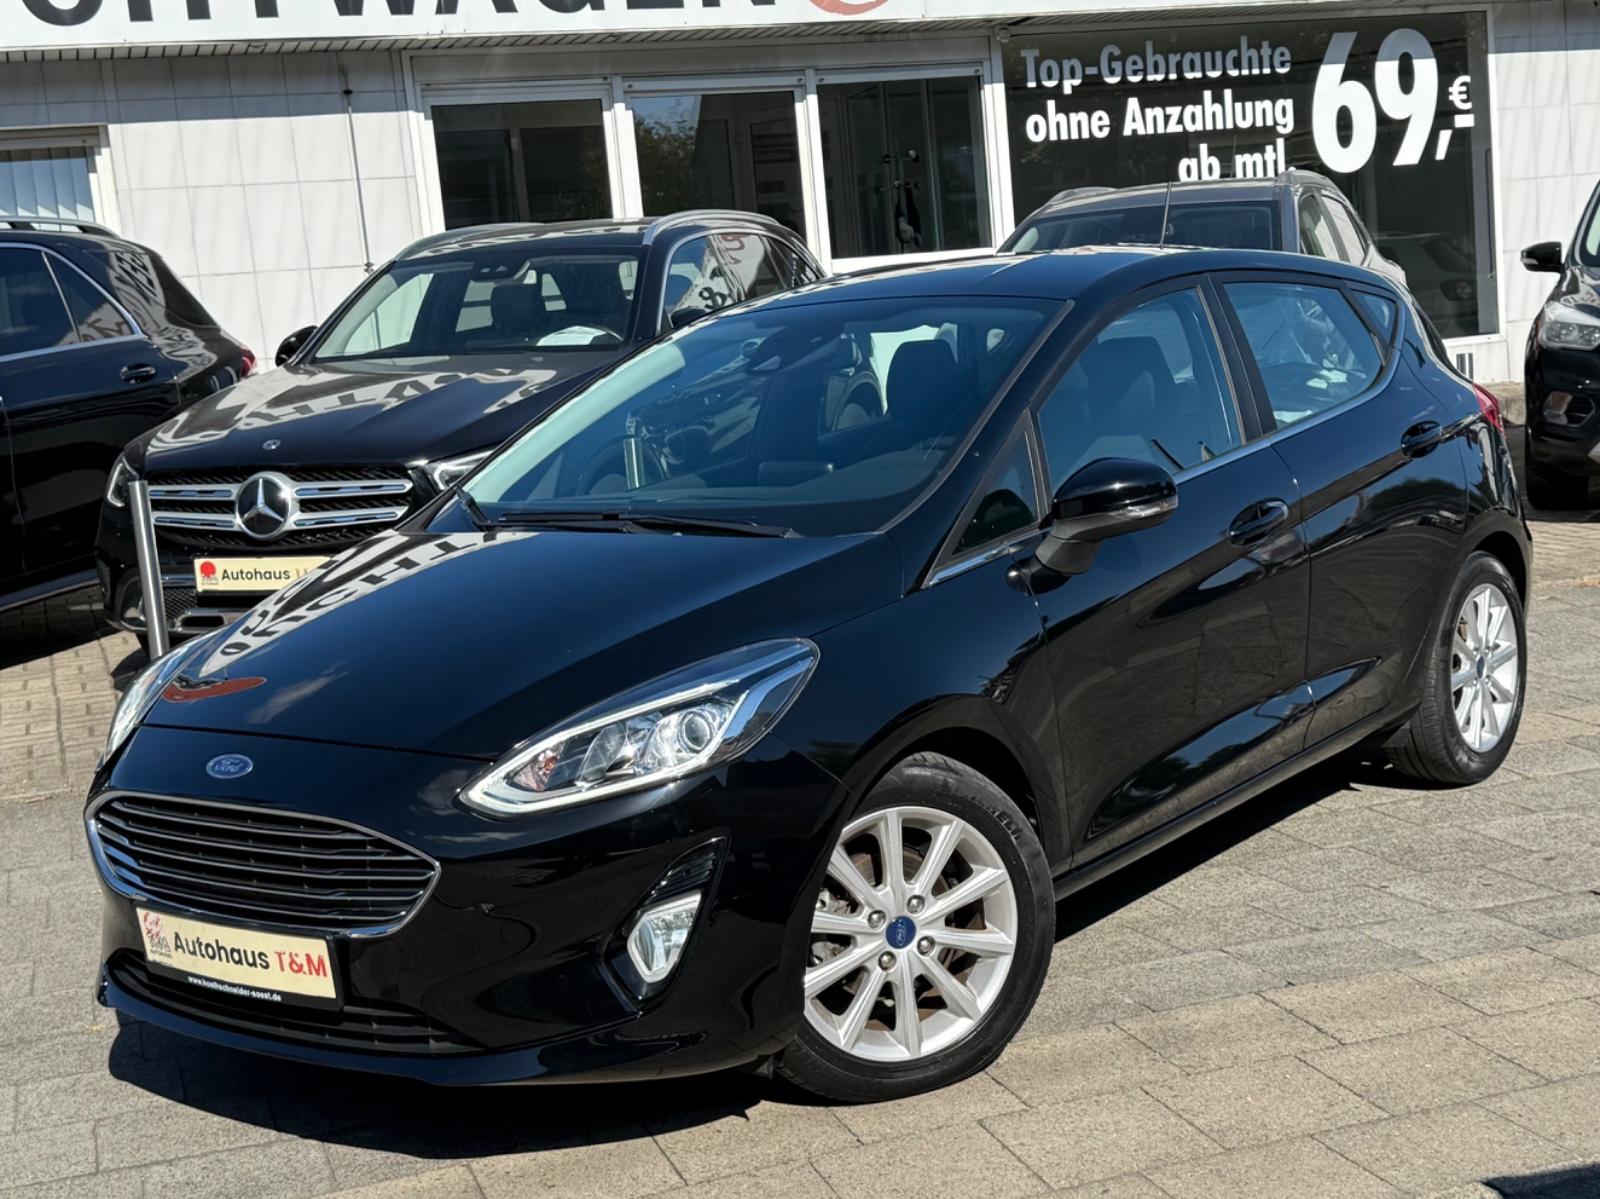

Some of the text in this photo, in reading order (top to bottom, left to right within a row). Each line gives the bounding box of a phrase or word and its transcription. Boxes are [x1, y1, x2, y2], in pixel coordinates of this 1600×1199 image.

[1020, 36, 1292, 94] Top-Gebrauchte
[1026, 88, 1294, 142] ohne Anzahlung
[1178, 143, 1221, 182] ab
[221, 568, 291, 580] Autohaus
[174, 931, 270, 970] Autohaus
[274, 950, 328, 978] T&M
